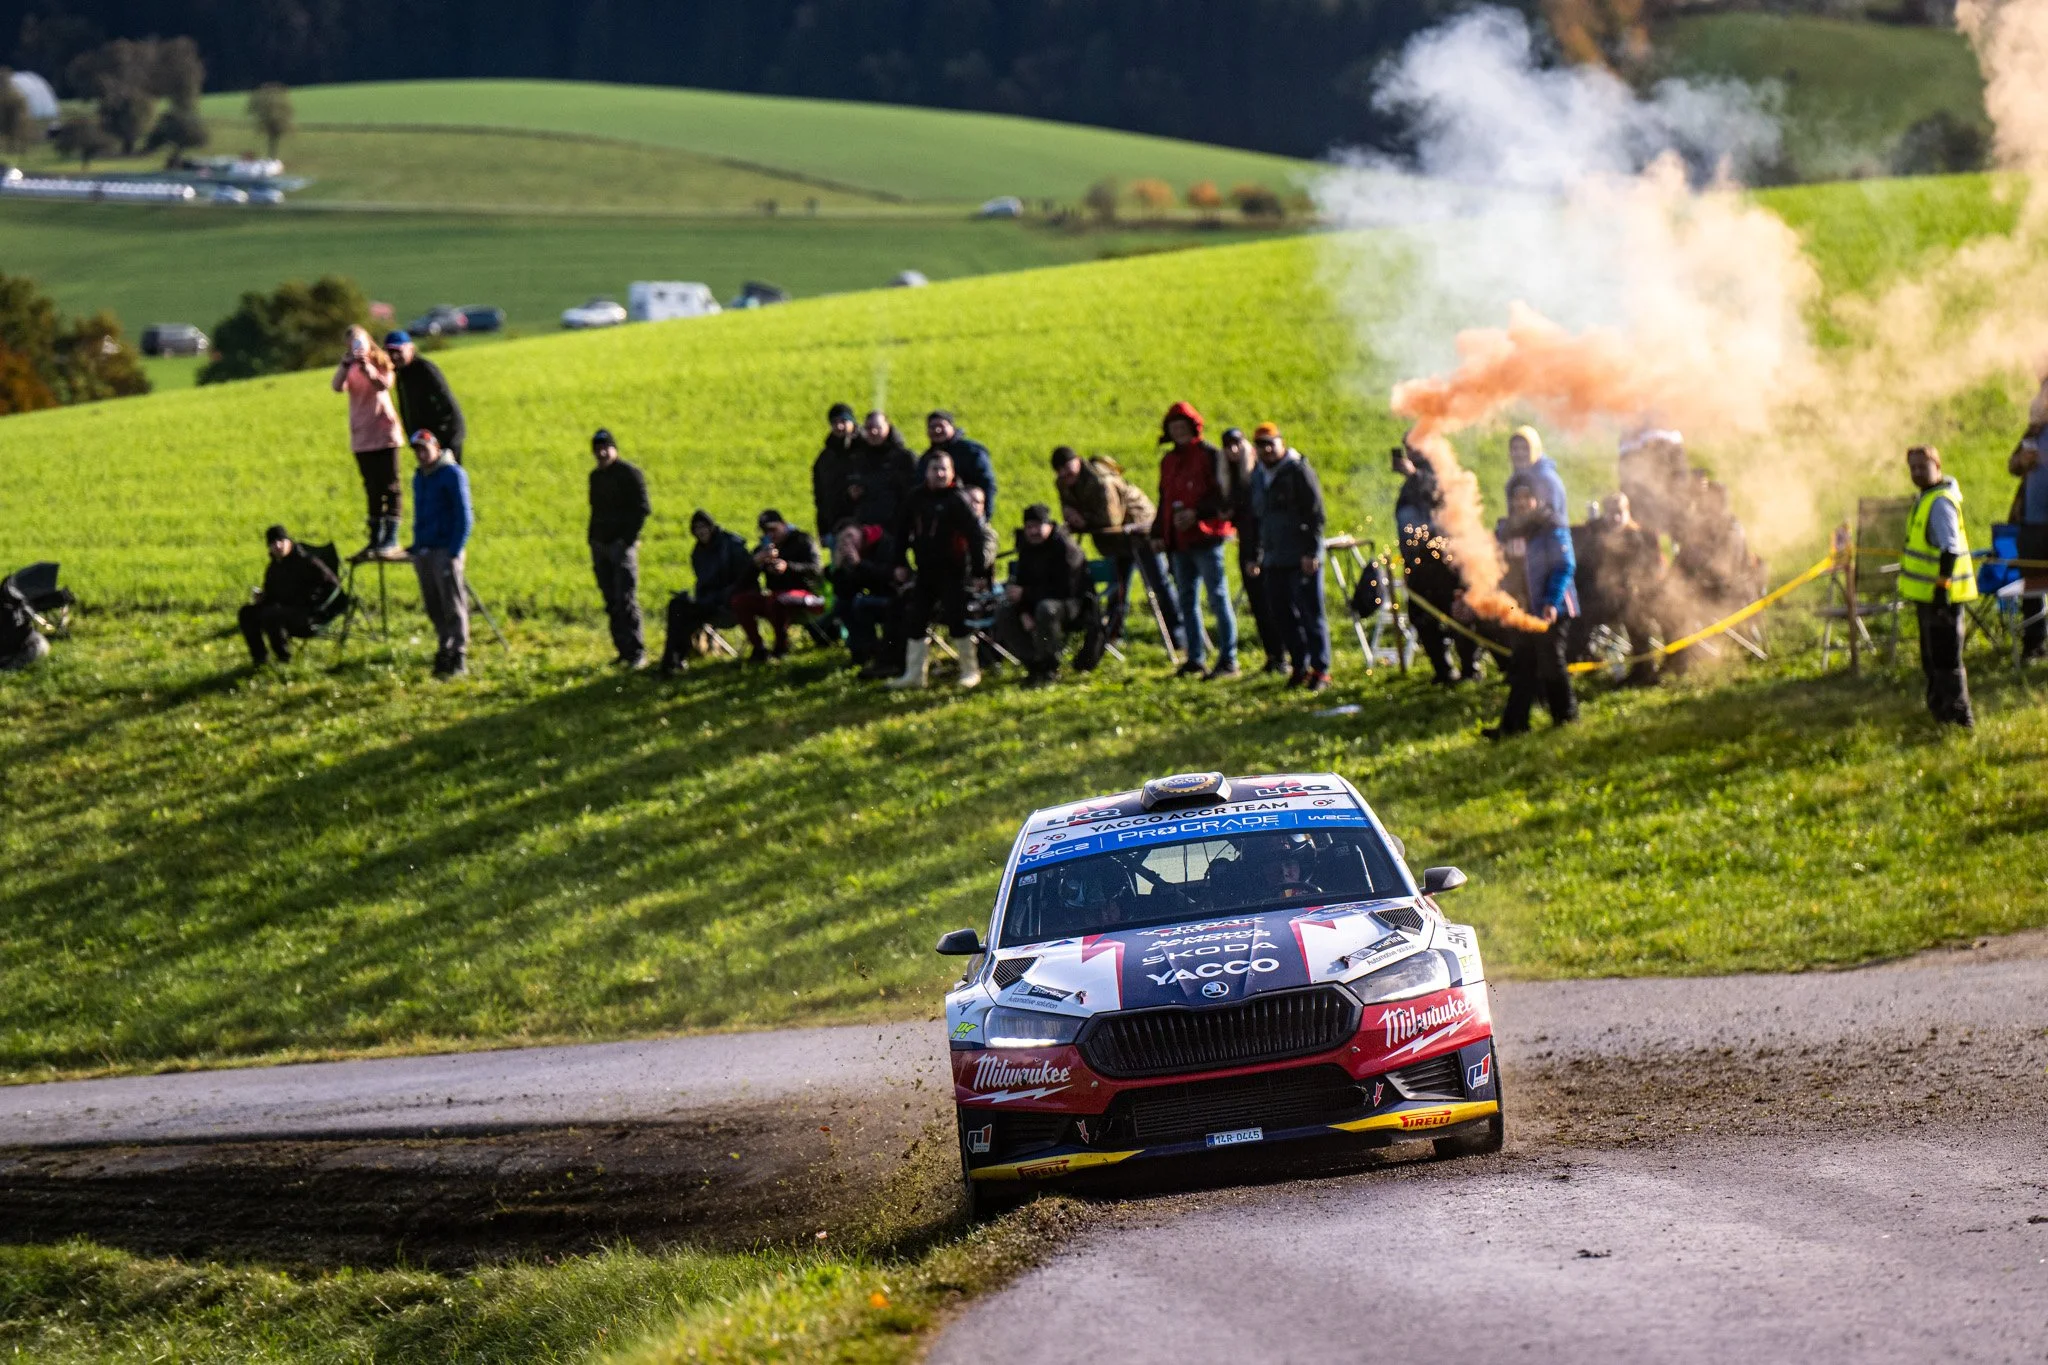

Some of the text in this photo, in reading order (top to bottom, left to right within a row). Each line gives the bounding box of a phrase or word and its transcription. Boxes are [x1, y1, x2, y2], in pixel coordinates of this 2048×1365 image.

[1255, 785, 1333, 797] LKQ
[1046, 808, 1122, 827] LKQ
[1091, 801, 1289, 833] YACCO ACCR TEAM
[1146, 958, 1280, 986] YACCO
[1377, 994, 1474, 1048] Milwaukee
[973, 1053, 1071, 1091] Milwaukee
[1400, 1110, 1452, 1128] PIRELLI
[1236, 1131, 1260, 1141] 0445
